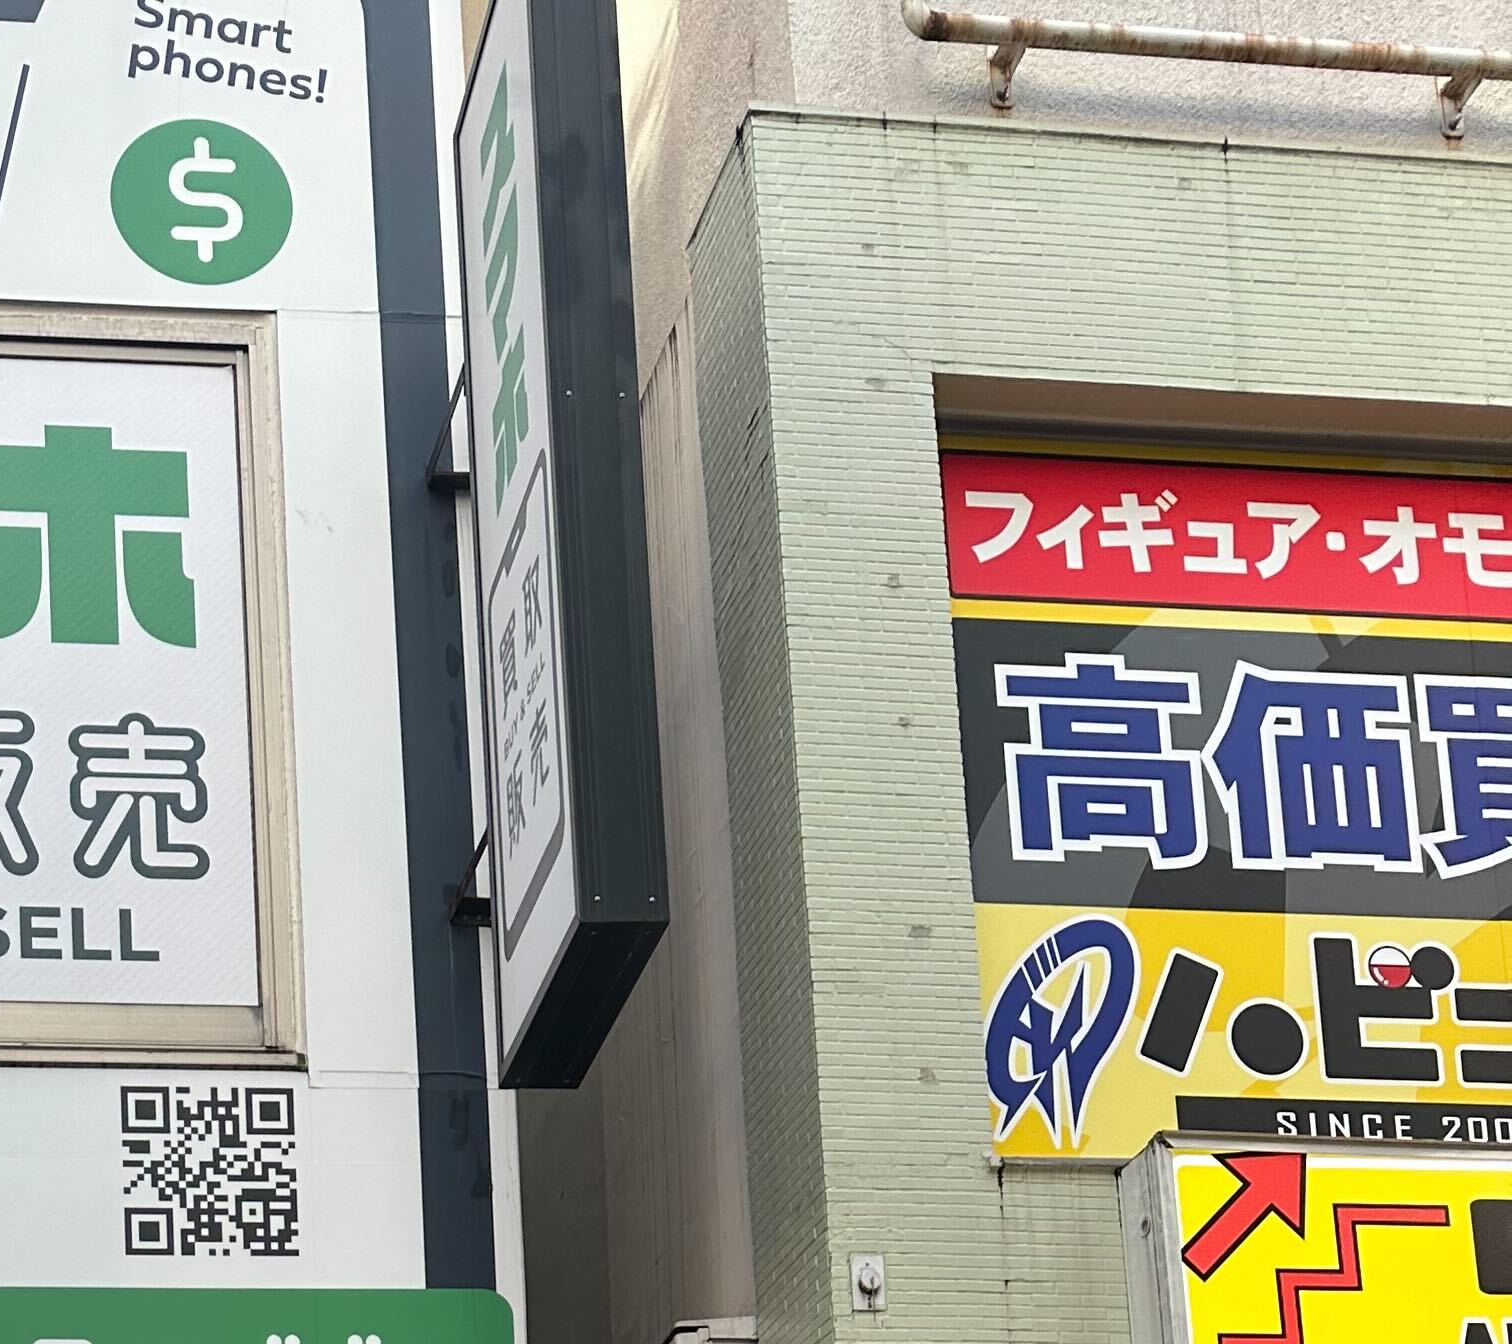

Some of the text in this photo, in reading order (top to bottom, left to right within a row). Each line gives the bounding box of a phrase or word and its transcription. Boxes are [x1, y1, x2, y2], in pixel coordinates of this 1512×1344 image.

[132, 0, 294, 56] Smart
[127, 37, 330, 105] phones!
[1275, 1111, 1414, 1141] SINCE
